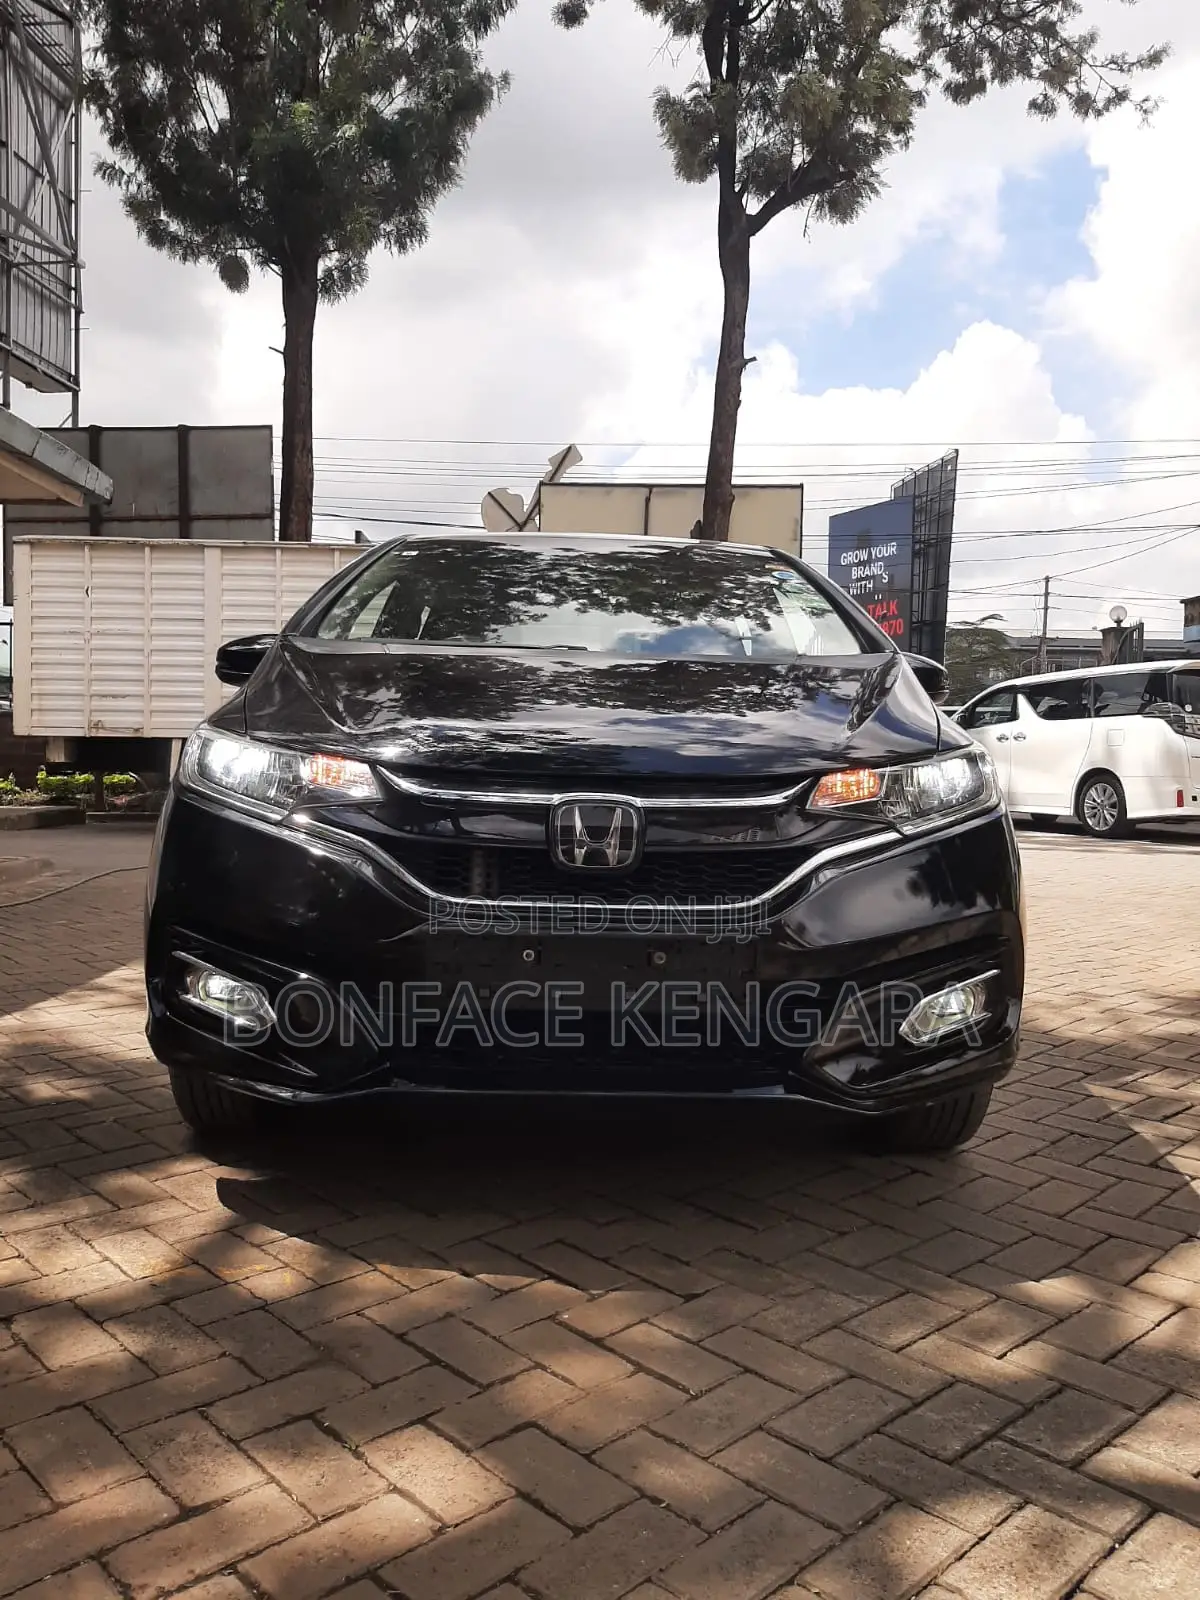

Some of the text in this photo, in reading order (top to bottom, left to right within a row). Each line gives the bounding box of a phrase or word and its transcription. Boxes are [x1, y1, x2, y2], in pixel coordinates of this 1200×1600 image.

[841, 542, 897, 565] GROW YOUR
[849, 580, 873, 595] WITH
[867, 600, 898, 620] TALK
[879, 619, 904, 636] 870
